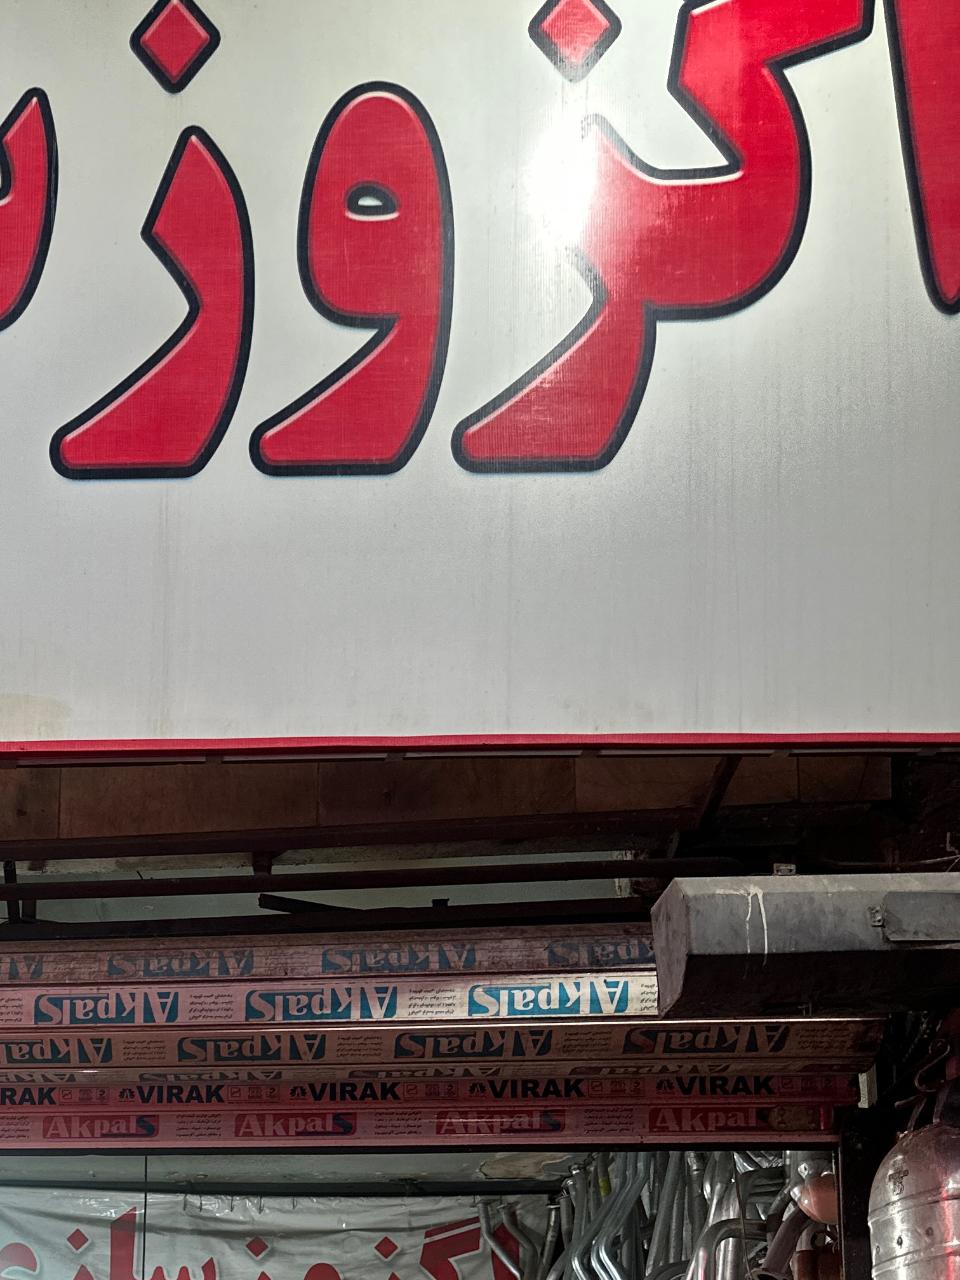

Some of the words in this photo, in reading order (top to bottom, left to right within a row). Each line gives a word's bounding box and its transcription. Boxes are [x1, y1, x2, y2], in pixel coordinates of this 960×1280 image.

[136, 1084, 225, 1104] VIRAK
[308, 1082, 401, 1101] VIRAK
[490, 1079, 585, 1099] VIRAK
[676, 1075, 776, 1096] VIRAK
